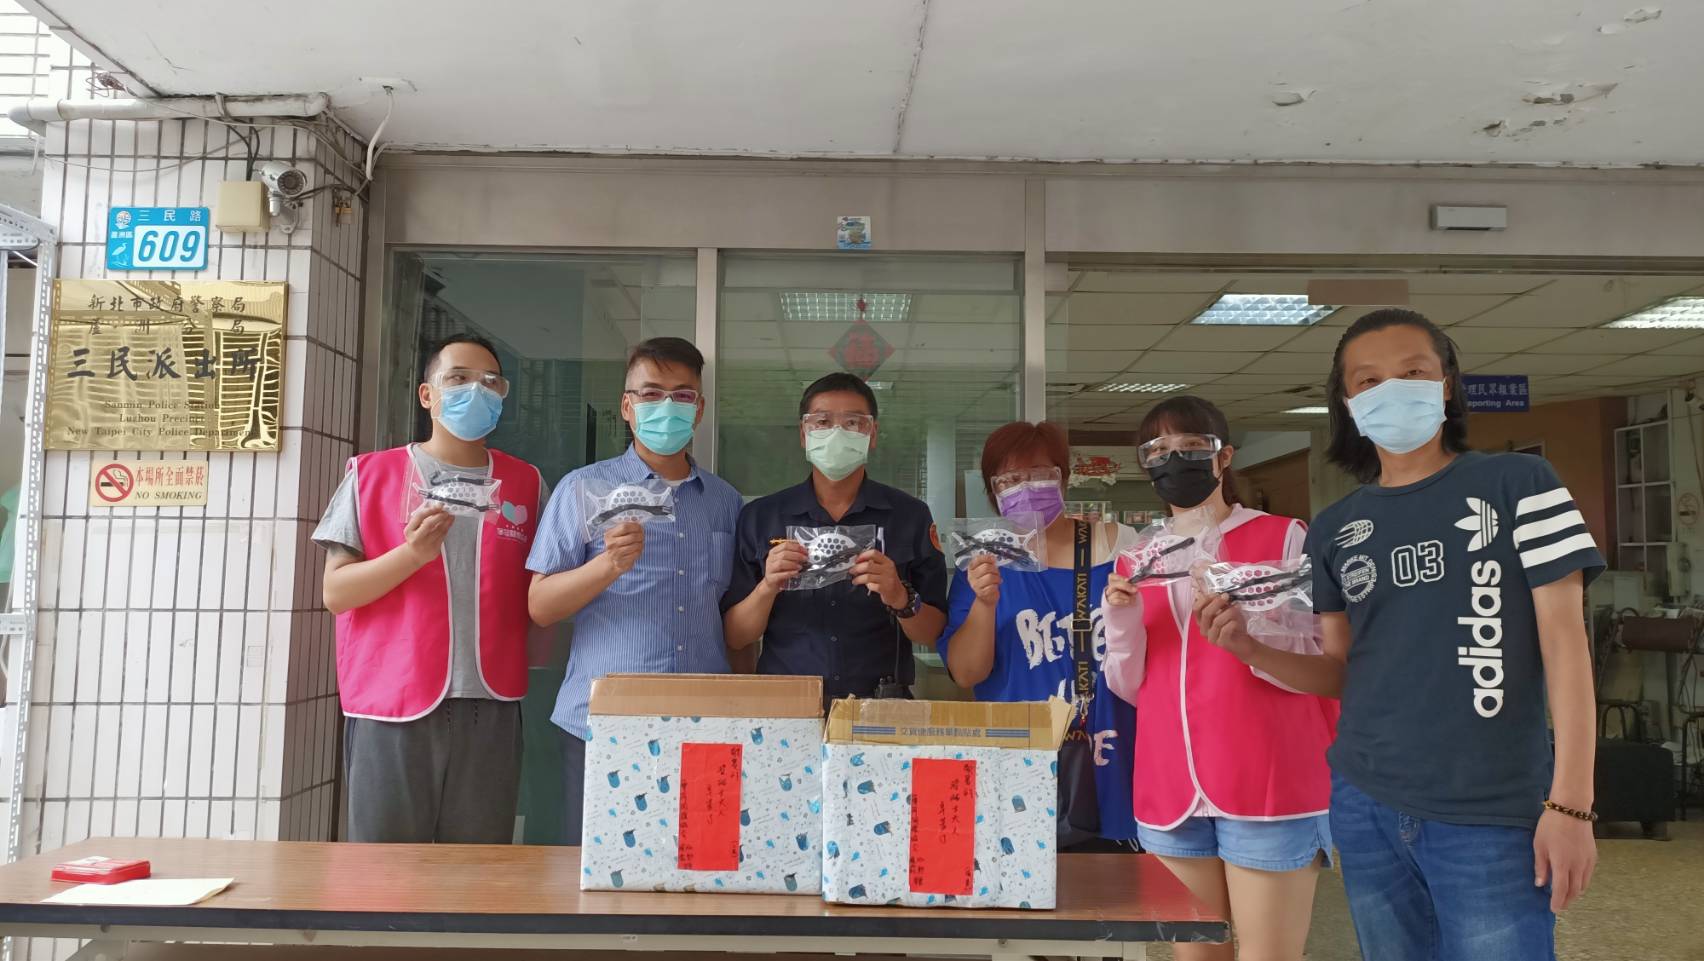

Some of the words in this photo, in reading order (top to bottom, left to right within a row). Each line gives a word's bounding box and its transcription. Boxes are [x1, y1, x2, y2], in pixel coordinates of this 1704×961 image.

[137, 209, 202, 222] 三民路
[138, 230, 201, 262] 609
[88, 294, 246, 313] 新北市政府警察局
[67, 346, 262, 381] 三民派出所
[104, 400, 143, 409] Sanmin
[148, 400, 179, 409] Police
[119, 414, 157, 423] Luzhou
[67, 427, 91, 436] New
[96, 427, 126, 438] Taipei
[132, 427, 153, 438] City
[158, 427, 188, 436] Police
[135, 491, 150, 500] NO
[154, 491, 202, 500] SMOKING
[1391, 540, 1445, 587] 03
[1458, 560, 1504, 718] adidas
